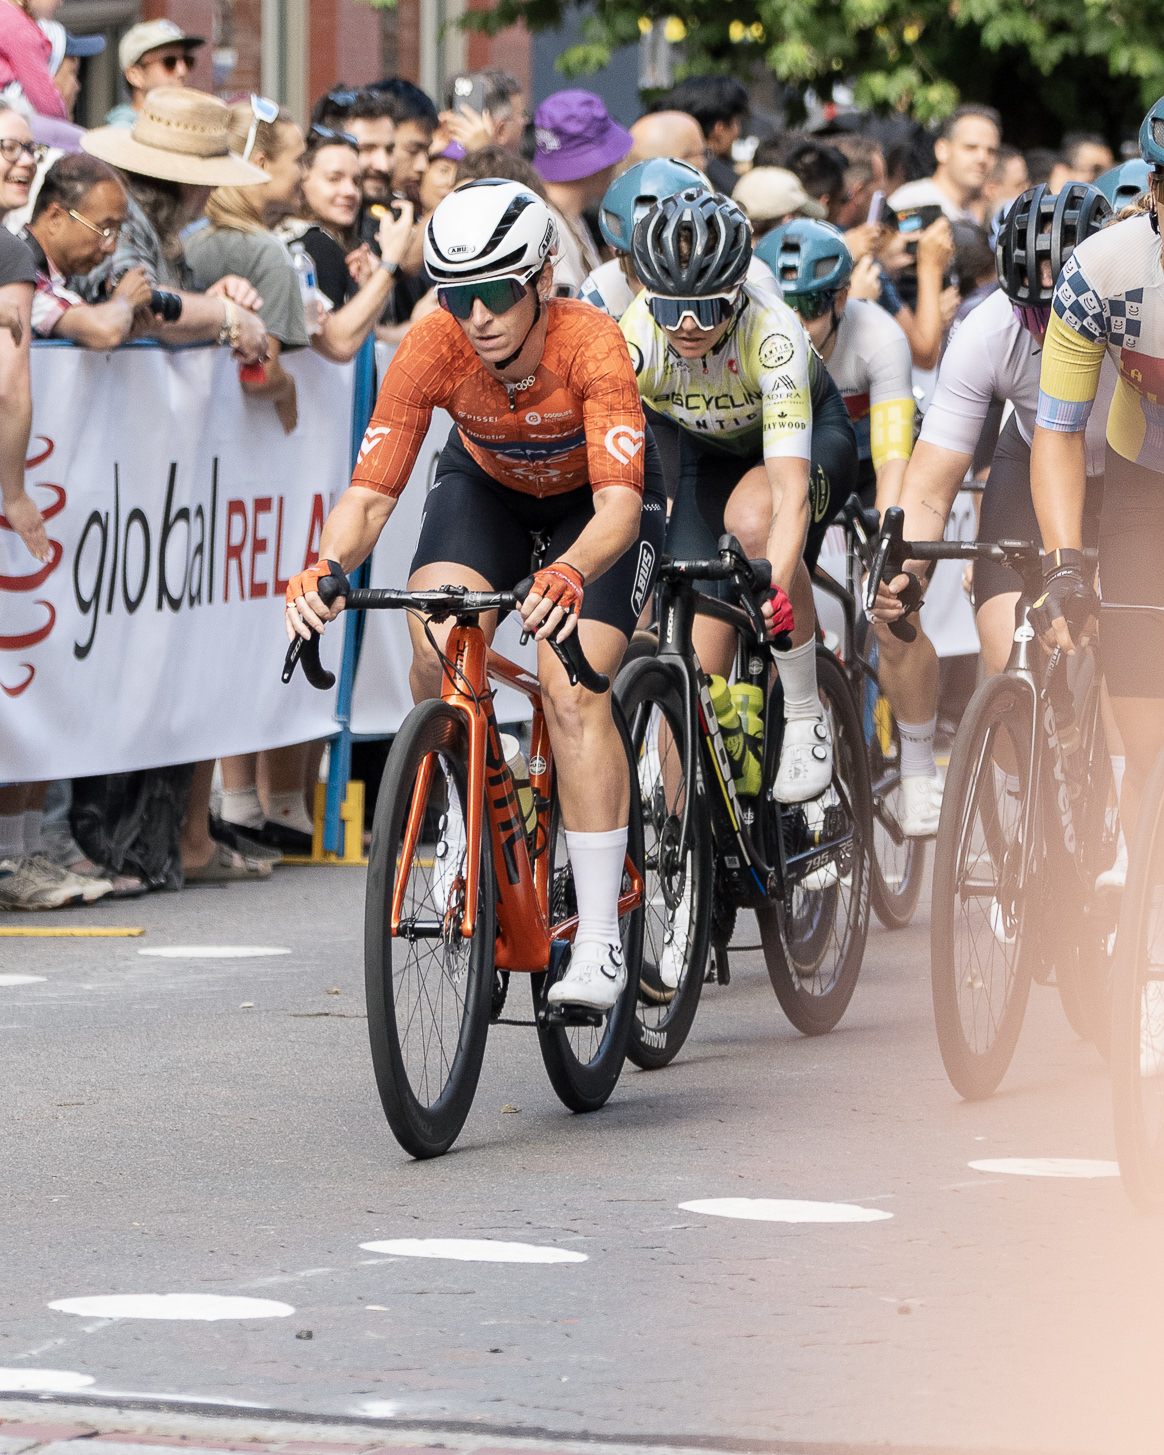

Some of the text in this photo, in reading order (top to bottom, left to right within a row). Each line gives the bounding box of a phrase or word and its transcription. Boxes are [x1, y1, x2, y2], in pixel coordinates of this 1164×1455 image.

[451, 246, 473, 254] ABU
[73, 457, 336, 660] global RELA
[635, 547, 654, 606] ABUS
[666, 606, 675, 644] LOOK
[805, 851, 829, 874] 795
